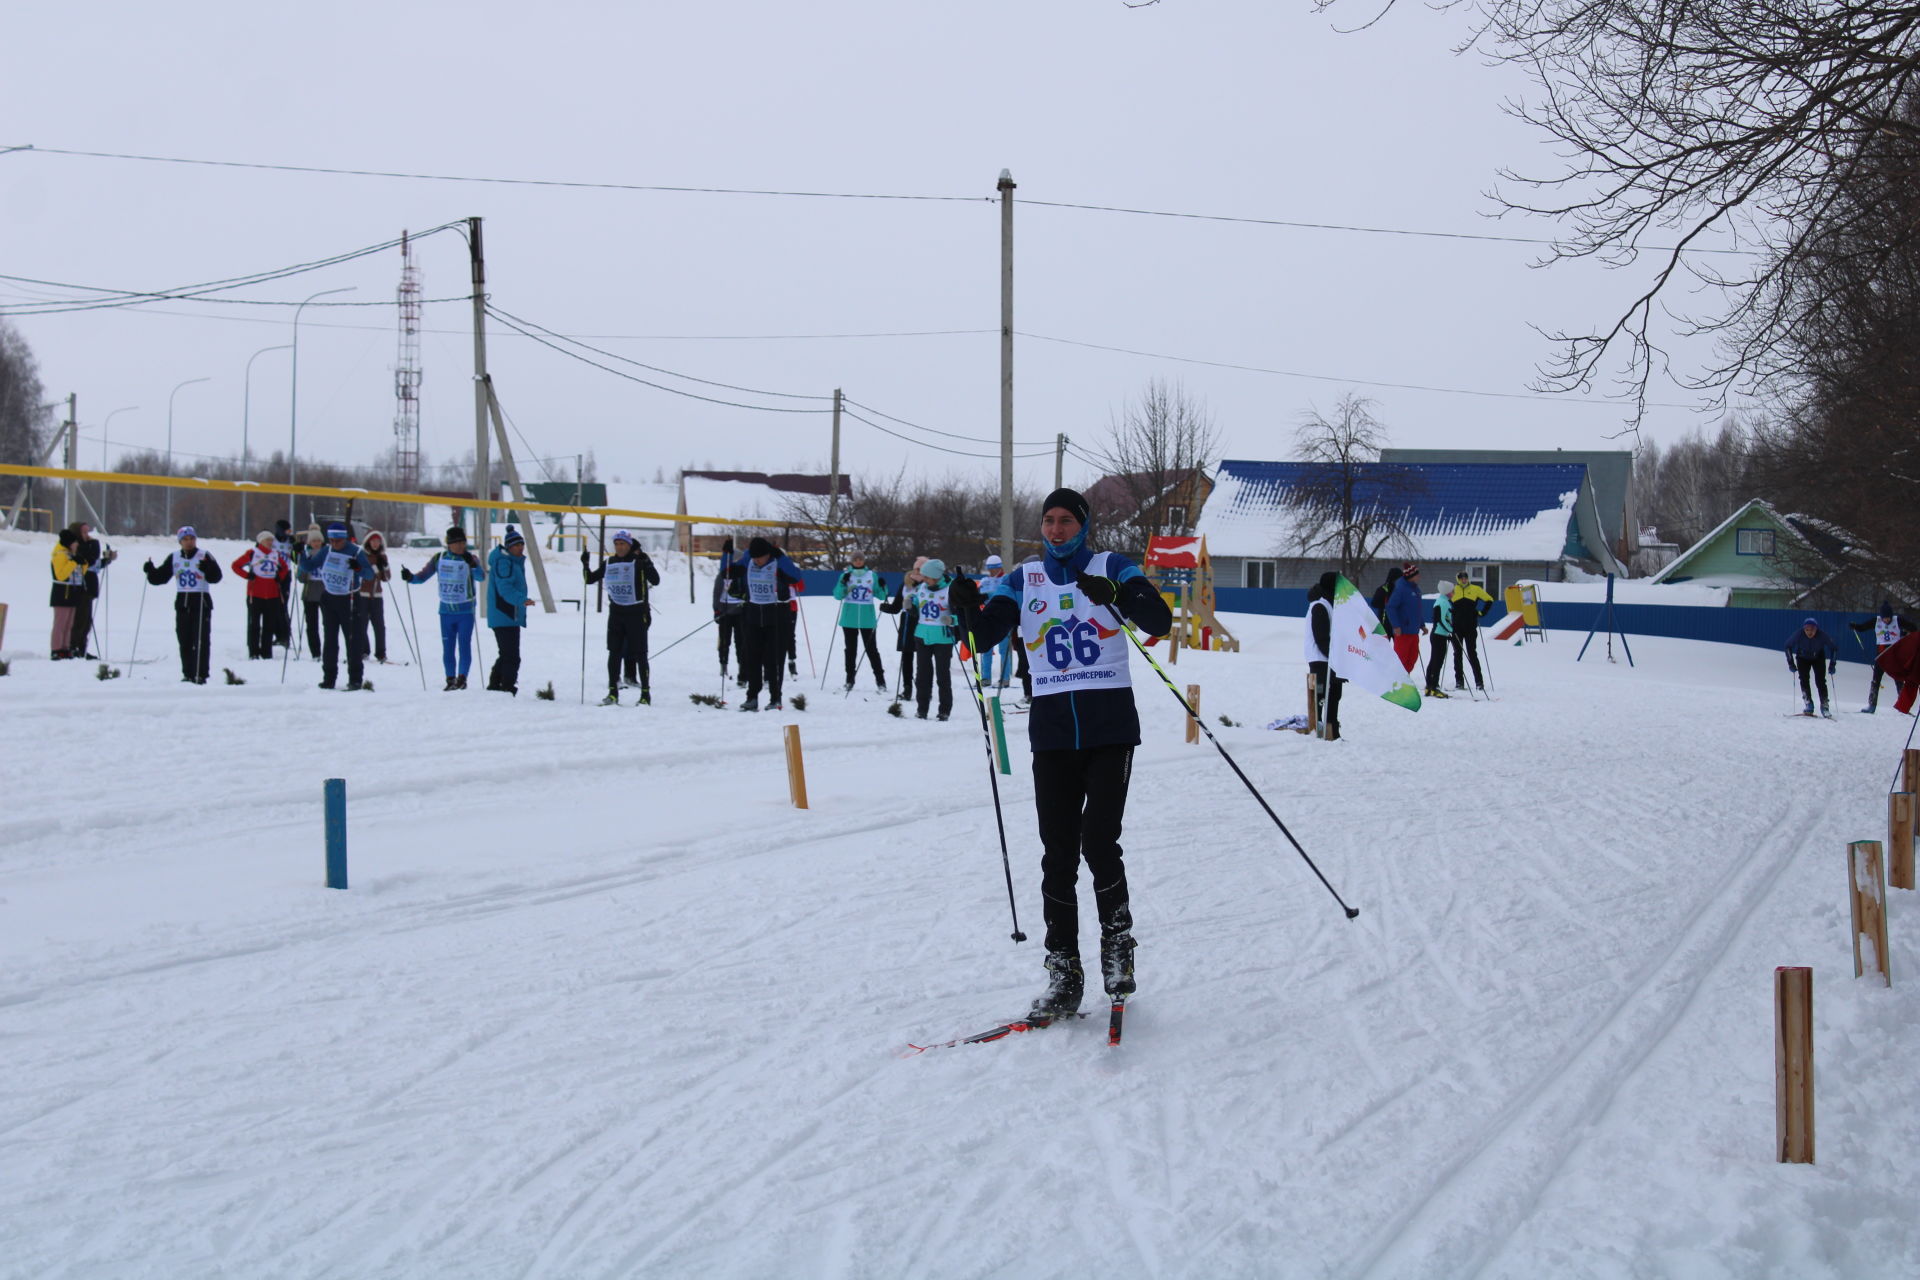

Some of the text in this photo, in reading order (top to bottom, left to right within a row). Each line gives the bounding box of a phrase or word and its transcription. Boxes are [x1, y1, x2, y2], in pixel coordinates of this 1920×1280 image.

[260, 559, 275, 572] 21
[179, 572, 197, 587] 68
[1028, 572, 1045, 583] ГТО
[440, 583, 465, 593] 12745
[750, 583, 774, 594] 12861
[851, 587, 867, 600] 87
[921, 604, 940, 619] 49
[1045, 621, 1101, 670] 66
[1036, 670, 1116, 685] ООО «ГАЗСТРОЙСЕРВИС»
